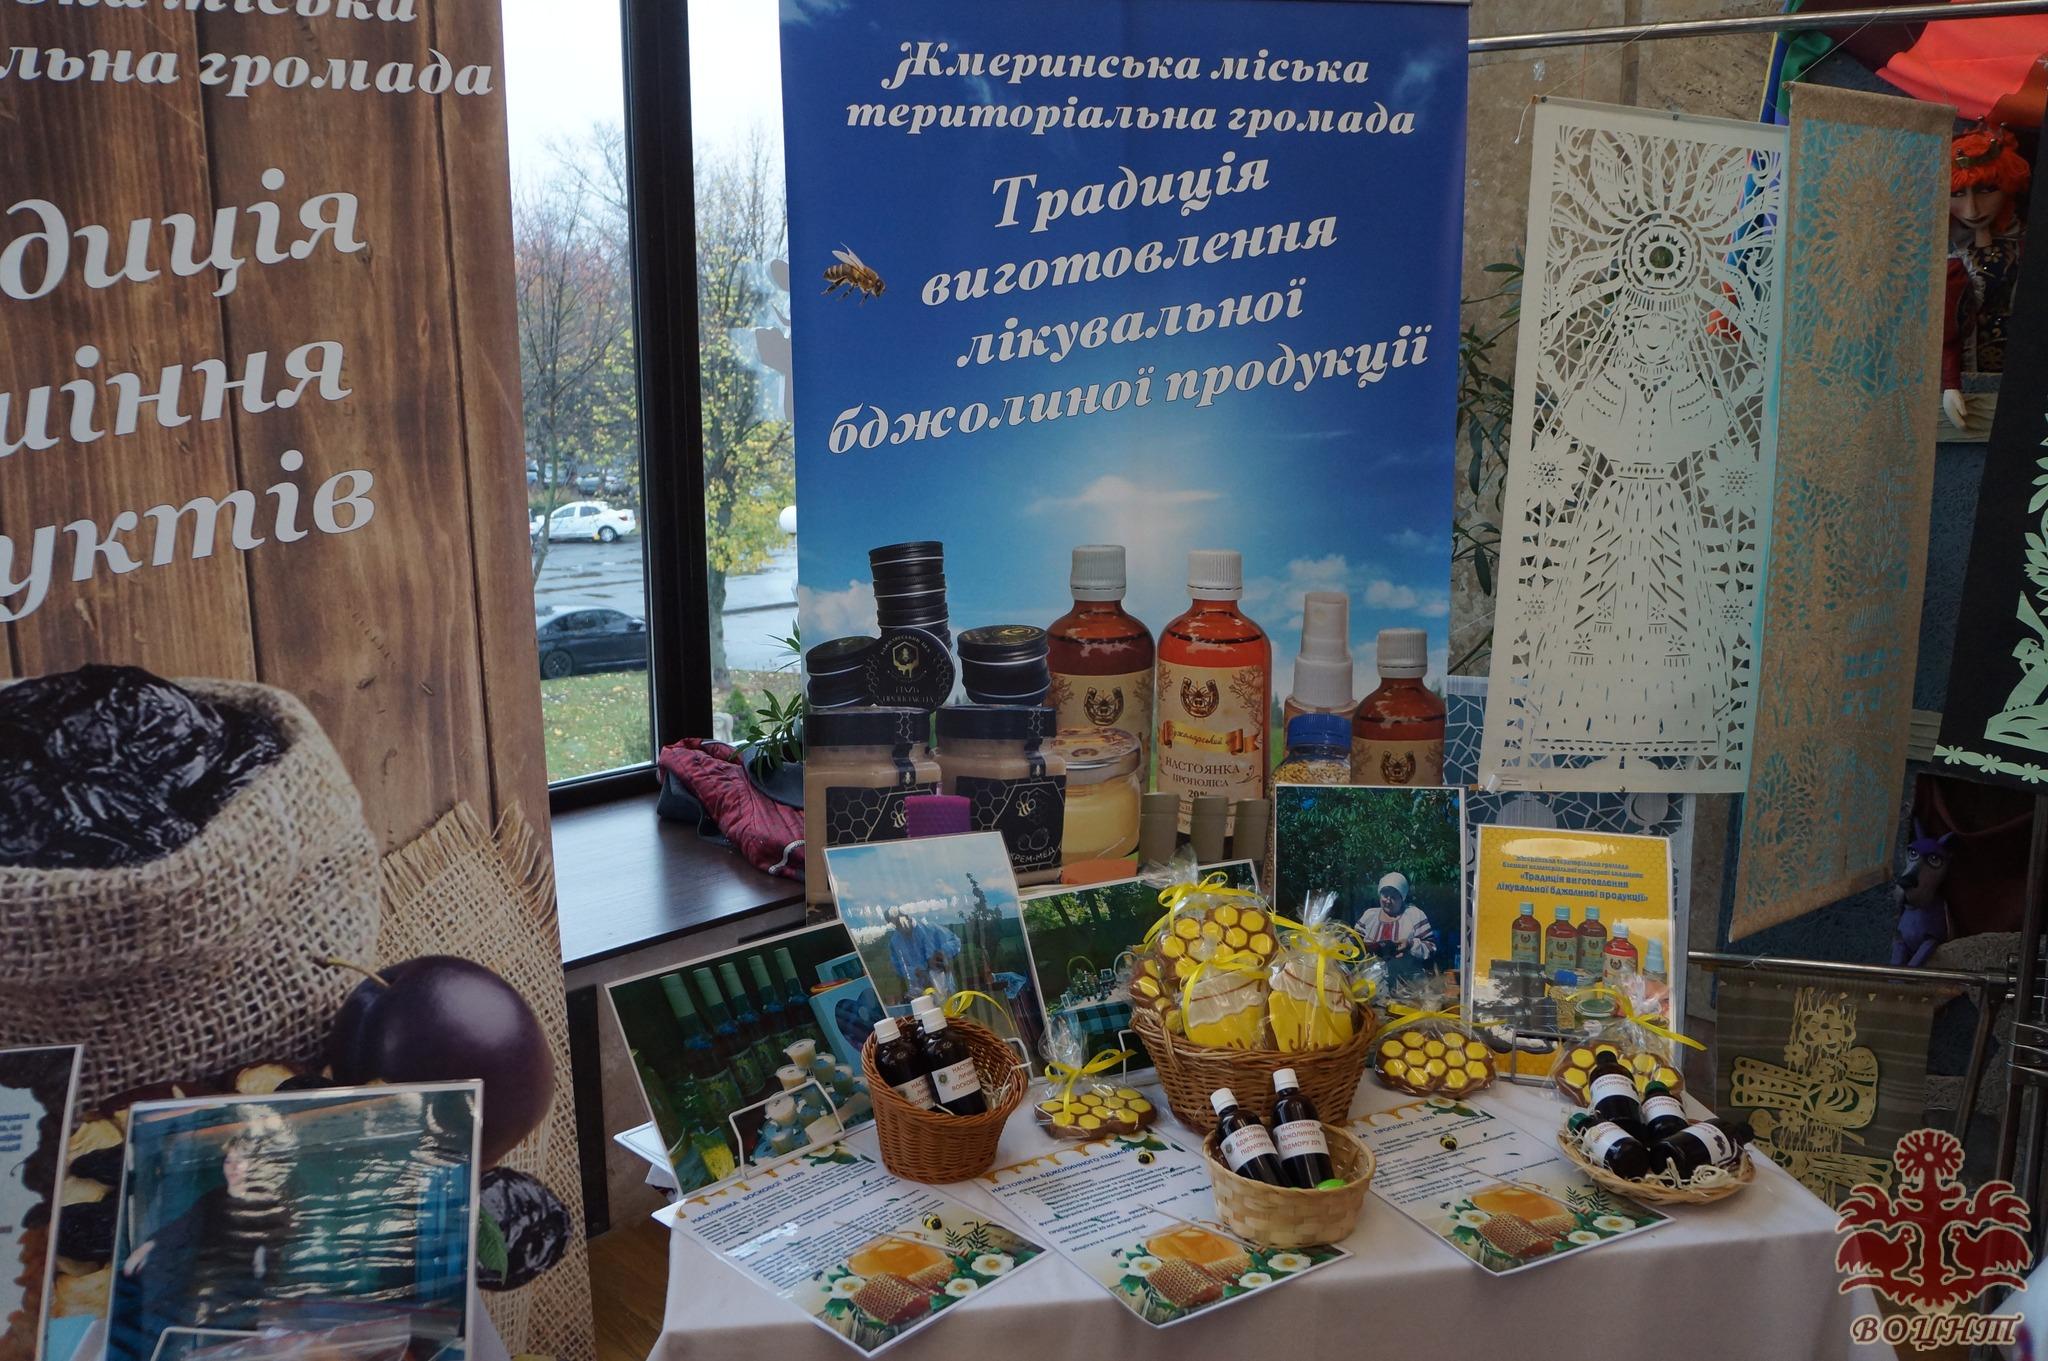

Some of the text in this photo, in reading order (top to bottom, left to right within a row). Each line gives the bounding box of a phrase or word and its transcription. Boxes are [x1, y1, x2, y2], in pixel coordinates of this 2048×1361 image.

[198, 47, 494, 98] громада
[881, 41, 1369, 90] Жмеринська міська
[846, 96, 1415, 138] територіальна громада
[0, 167, 369, 300] диція
[992, 151, 1269, 233] Традиція
[921, 216, 1337, 306] виготовлення
[956, 277, 1307, 368] лікувальної
[828, 324, 1433, 455] бджолиної продукції
[0, 449, 378, 623] уктів
[1165, 756, 1240, 775] НАСТОЯНКА
